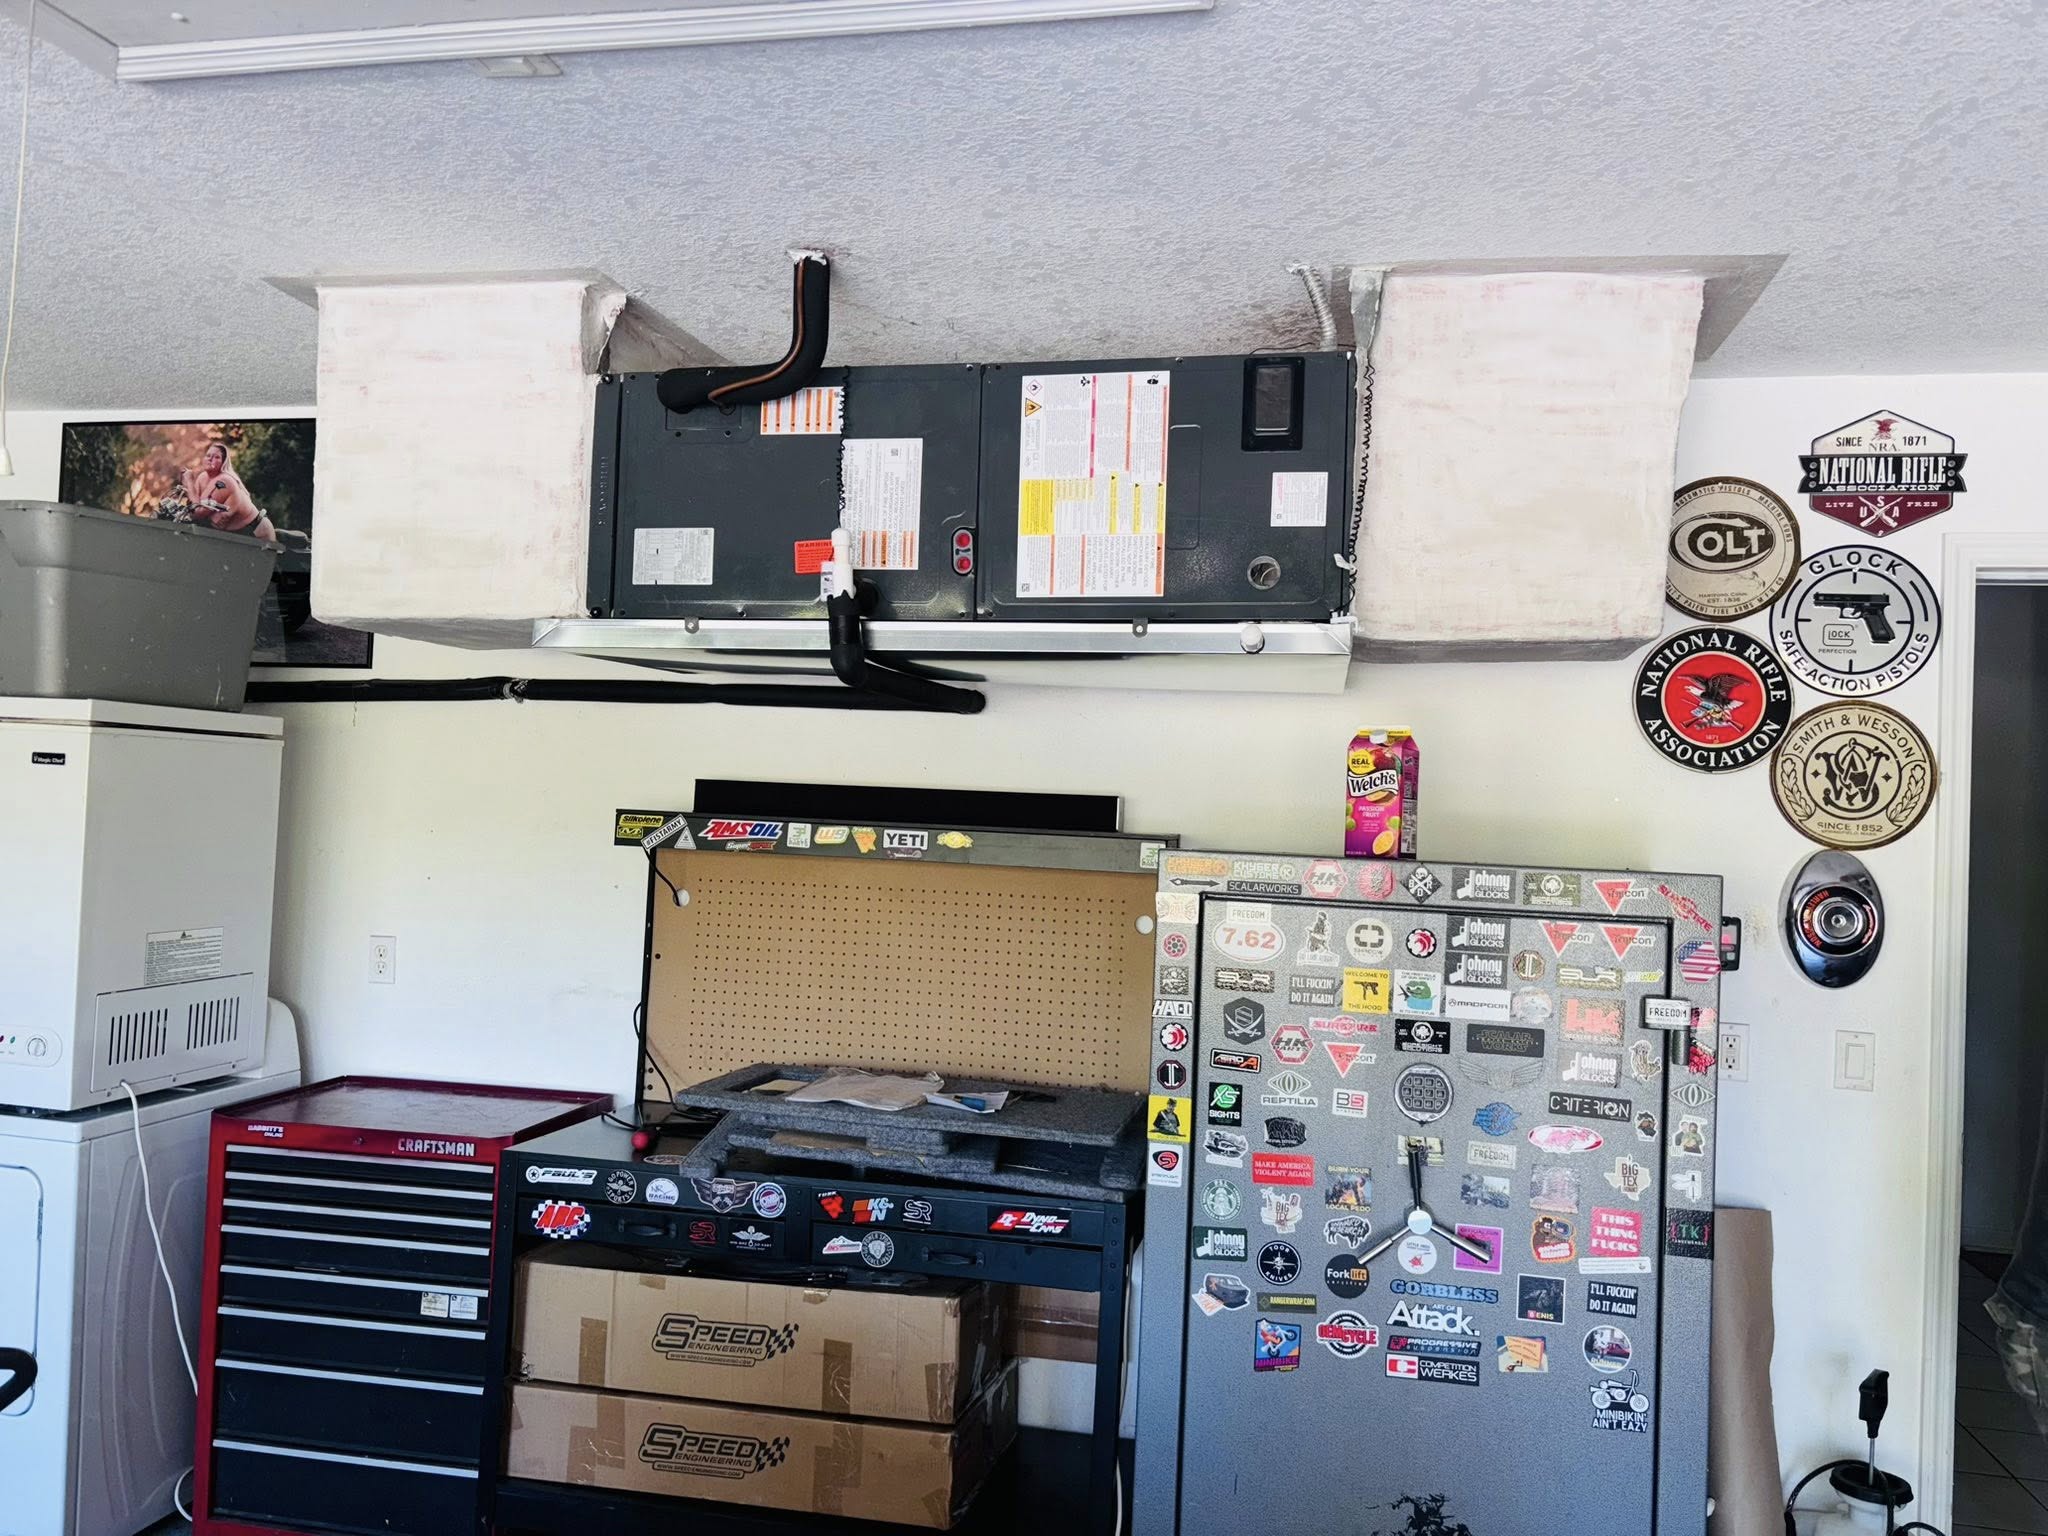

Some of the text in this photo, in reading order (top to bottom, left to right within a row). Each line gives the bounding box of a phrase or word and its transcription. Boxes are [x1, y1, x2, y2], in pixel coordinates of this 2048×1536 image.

[1836, 437, 1862, 447] SINCE
[1903, 436, 1927, 446] 1871
[1819, 457, 1946, 484] NATIONAL RIFLE
[1822, 484, 1942, 492] ASSOCIATION
[1675, 484, 1793, 543] AUTOMATIC PISTOLS MACHINE GUNS
[1809, 551, 1903, 576] GLOCK
[1684, 600, 1754, 615] PATENT FIRE ARMS
[1641, 632, 1787, 703] NATIONAL RIFLE
[1779, 630, 1930, 692] SAFE-ACTION PISTOLS
[1644, 718, 1782, 767] ASSOCIATION
[1793, 714, 1916, 759] SMITH & WESSON
[1351, 758, 1370, 766] REAL
[1350, 771, 1396, 793] Welch's
[623, 815, 662, 823] Silkolene
[704, 821, 781, 838] AMSOIL
[1817, 821, 1883, 832] SINCE 1852
[886, 832, 925, 847] YETI
[1468, 870, 1510, 889] Johnny
[1229, 881, 1299, 894] SCALARWORKS
[1475, 890, 1509, 900] GLOCKS
[1463, 918, 1505, 937] Johnny
[1222, 928, 1276, 949] 7.62
[1470, 939, 1504, 948] GLOCKS
[1462, 955, 1502, 975] Johnny
[1292, 978, 1334, 990] I'LL FUCKIN'
[1468, 975, 1502, 985] GLOCKS
[1291, 992, 1334, 1005] DO IT AGAIN
[1649, 1007, 1687, 1018] FREEDOM
[1477, 1030, 1533, 1041] SCALAR
[1482, 1041, 1528, 1052] WORKS
[1580, 1073, 1615, 1084] GLOCKS
[1210, 1087, 1240, 1106] XS
[1262, 1096, 1317, 1107] REPTILIA
[1550, 1095, 1630, 1118] CRITERION
[1209, 1110, 1240, 1119] SIGHTS
[397, 1138, 475, 1157] CRAFTSMAN
[1277, 1162, 1311, 1170] AMERICA
[1621, 1163, 1639, 1176] BIG
[608, 1171, 634, 1186] GO POWER
[1255, 1169, 1312, 1178] VIOLENT AGAIN
[1622, 1175, 1638, 1186] TEX
[606, 1189, 633, 1204] SPORTS
[648, 1193, 676, 1201] RACING
[903, 1199, 932, 1222] SR
[1275, 1201, 1290, 1213] BIG
[1276, 1212, 1289, 1221] TEX
[1600, 1213, 1635, 1226] THIS
[1594, 1226, 1638, 1240] THING
[863, 1233, 879, 1246] POWER
[879, 1234, 893, 1252] SPORTS
[1208, 1230, 1245, 1250] Johnny
[1591, 1239, 1638, 1252] FUCKS
[1214, 1248, 1245, 1257] GLOCKS
[1269, 1245, 1290, 1253] TOOR
[1265, 1272, 1293, 1282] KNIVES
[1590, 1283, 1637, 1299] I'LL FUCKIN'
[1270, 1296, 1315, 1305] RANGERWRAP.COM
[1589, 1300, 1637, 1315] DO IT AGAIN
[655, 1318, 768, 1349] SPEED
[688, 1344, 762, 1355] ENGINEERING
[1407, 1338, 1478, 1350] PROGRESSIVE
[1420, 1361, 1477, 1372] COMPETITION
[1420, 1367, 1477, 1382] WERKES
[1596, 1409, 1647, 1422] MINIBIKIN'
[1592, 1419, 1648, 1432] AIN'T EAZY
[642, 1428, 757, 1460] SPEED
[675, 1453, 752, 1468] ENGINEERING
